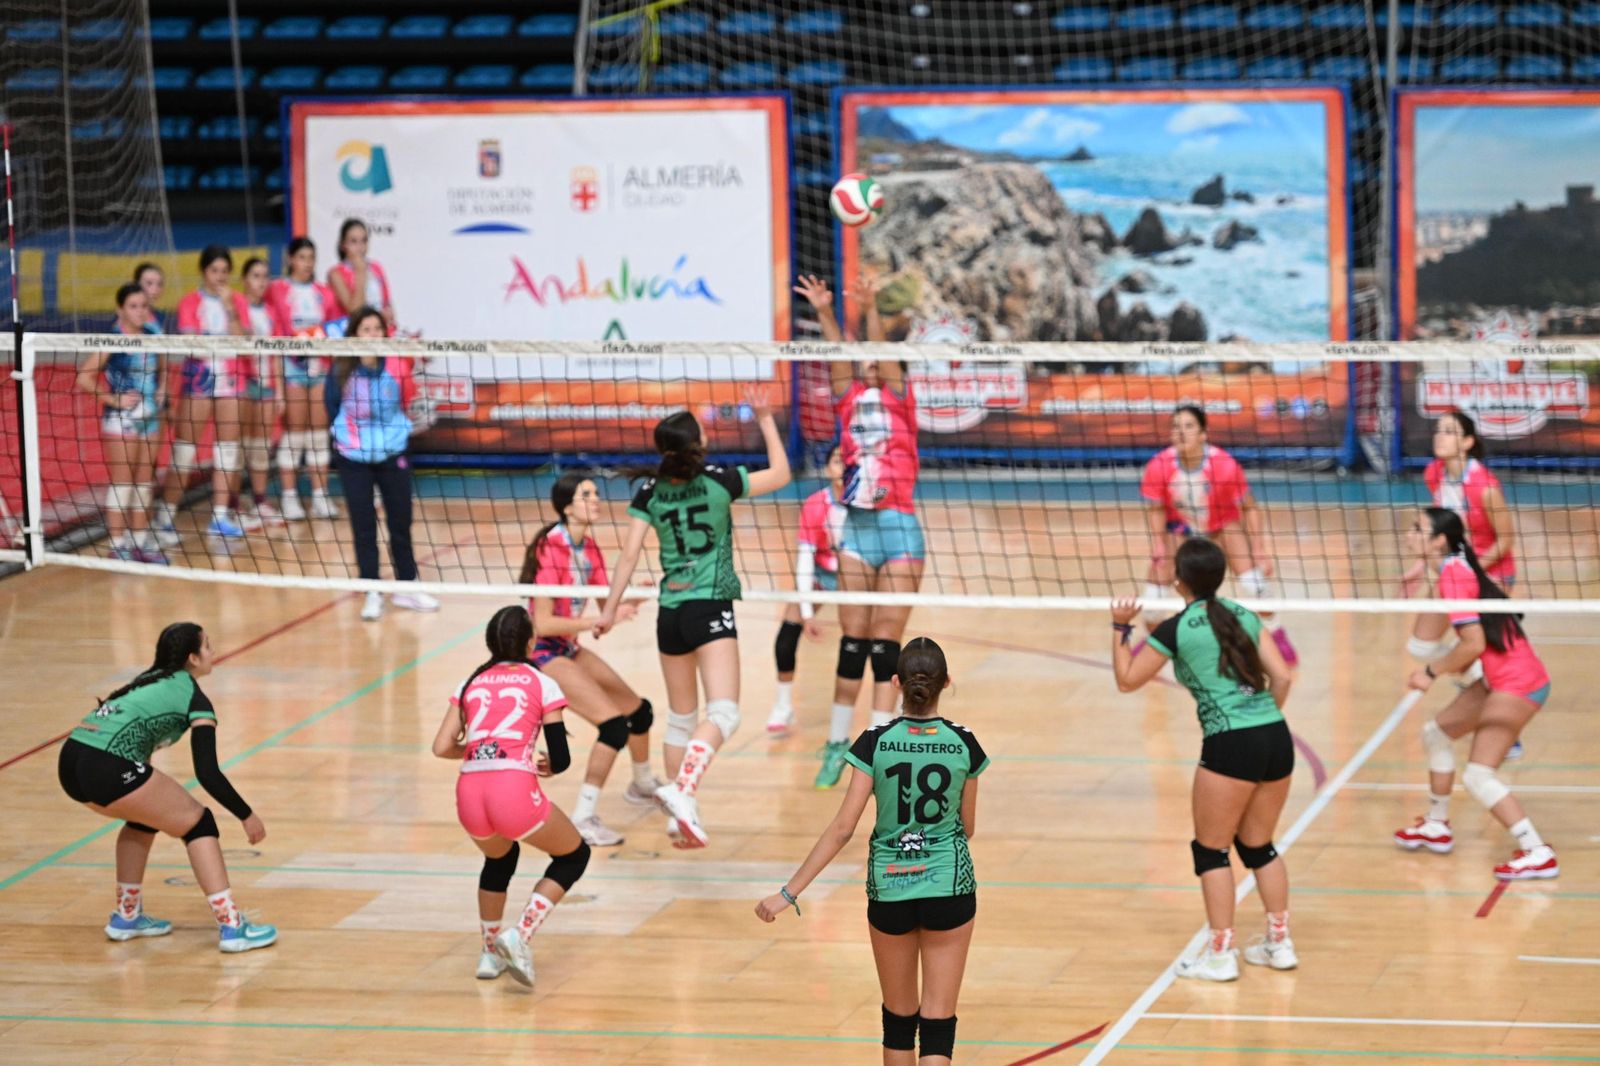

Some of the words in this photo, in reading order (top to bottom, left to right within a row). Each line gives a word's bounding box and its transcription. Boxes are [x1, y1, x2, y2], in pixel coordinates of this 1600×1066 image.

[623, 160, 743, 187] ALMERÍA
[504, 254, 724, 306] Andalucía
[660, 504, 715, 557] 15
[472, 674, 532, 686] GALINDO
[466, 686, 529, 742] 22
[879, 740, 963, 755] BALLESTEROS
[884, 762, 952, 825] 18
[895, 850, 931, 862] ARES
